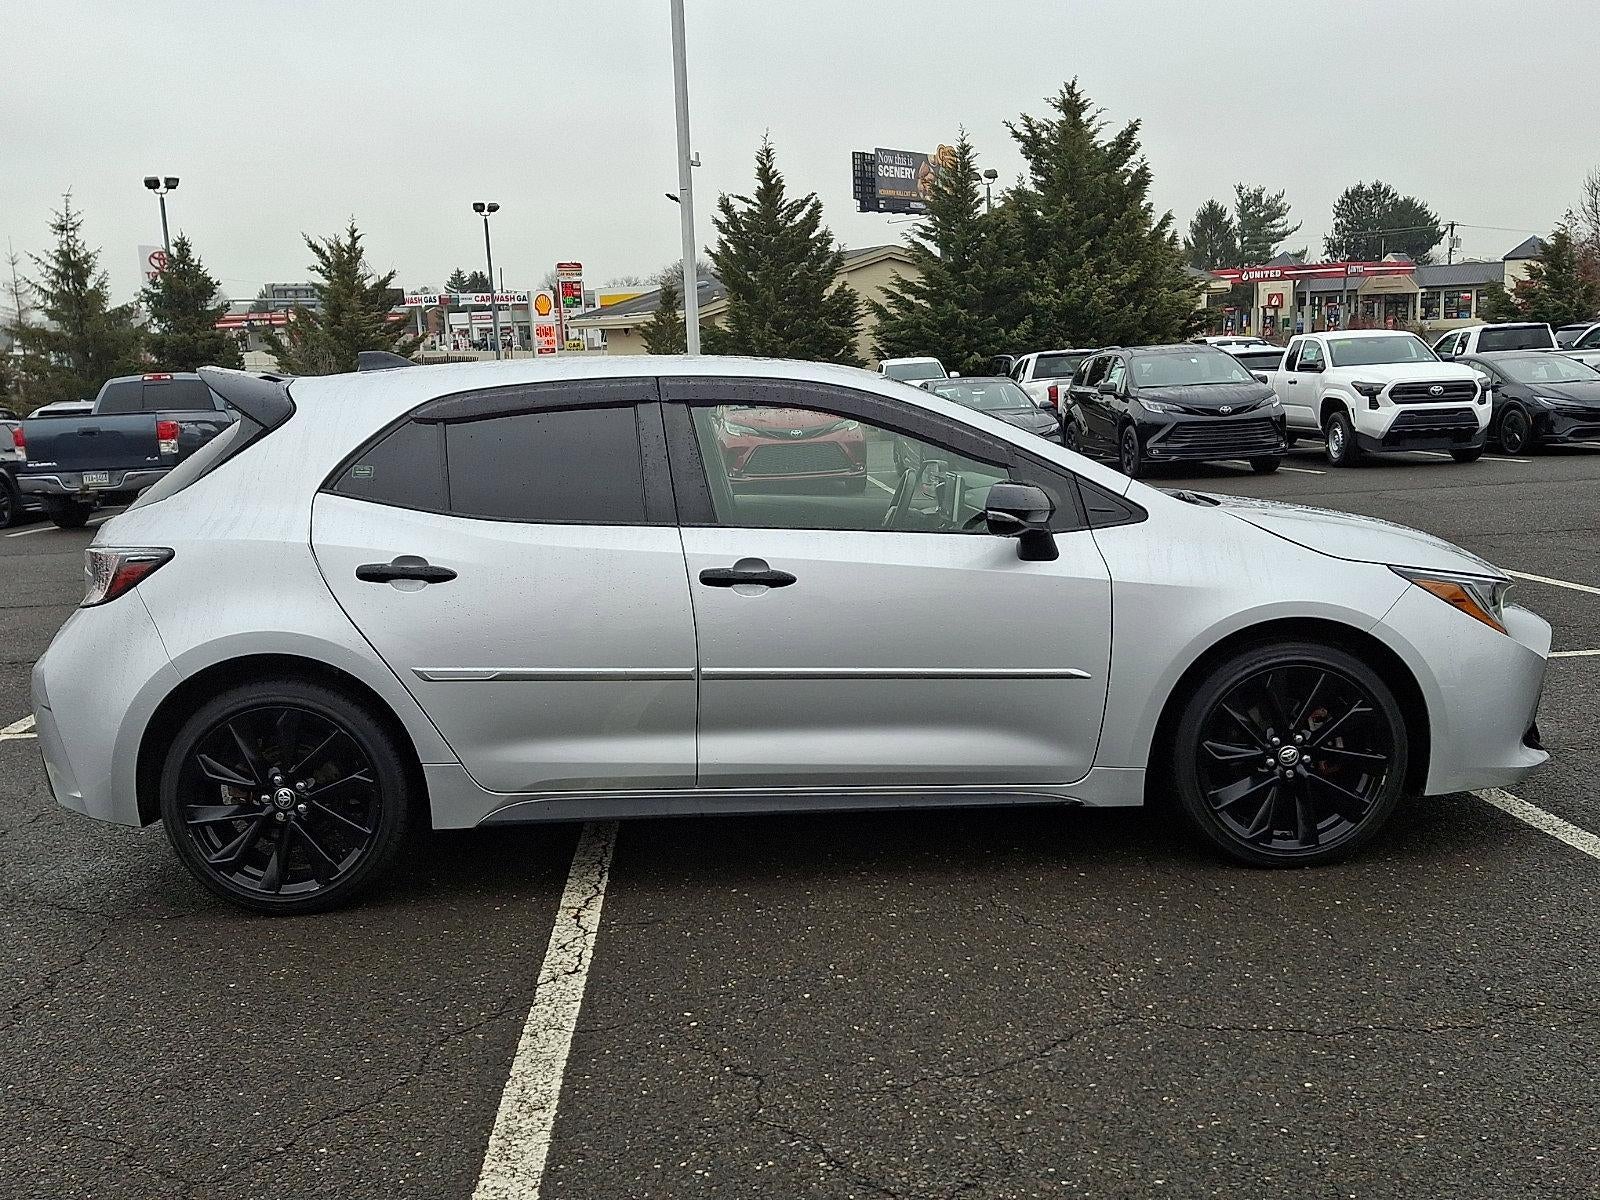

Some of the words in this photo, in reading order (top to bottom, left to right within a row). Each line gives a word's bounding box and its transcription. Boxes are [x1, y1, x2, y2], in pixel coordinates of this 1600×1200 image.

[878, 151, 894, 164] Now
[895, 153, 907, 165] this
[907, 156, 913, 166] is
[878, 164, 916, 179] SCENERY
[1249, 269, 1281, 279] UNITED
[423, 295, 437, 304] GAS
[474, 294, 491, 303] CAR
[516, 294, 528, 303] GA
